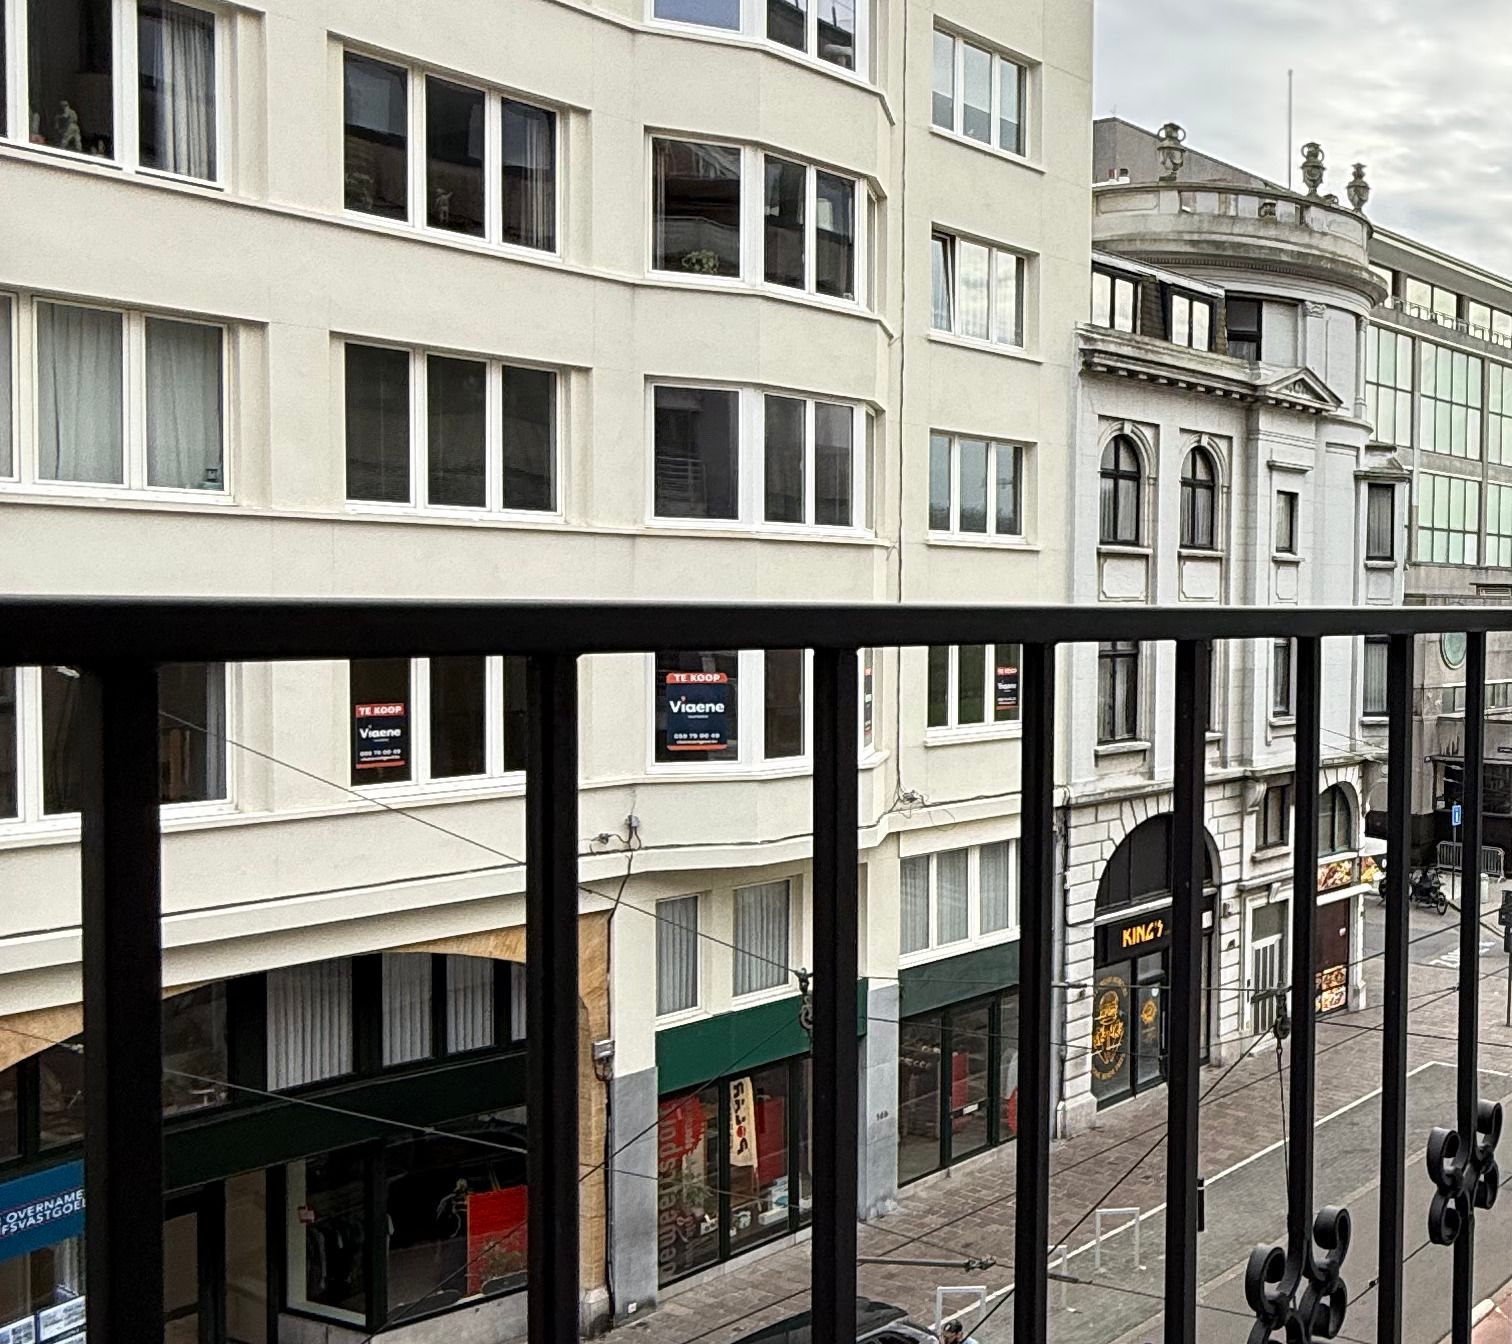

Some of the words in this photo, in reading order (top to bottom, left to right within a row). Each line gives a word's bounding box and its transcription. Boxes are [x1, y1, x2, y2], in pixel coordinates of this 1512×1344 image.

[673, 674, 687, 682] TE
[690, 673, 720, 682] KOOP
[359, 707, 371, 716] TE
[373, 706, 402, 715] KOOP
[669, 696, 725, 713] Viaene
[359, 724, 402, 739] Viaene
[1122, 919, 1164, 948] KING'S
[6, 1189, 86, 1223] OVERNAME
